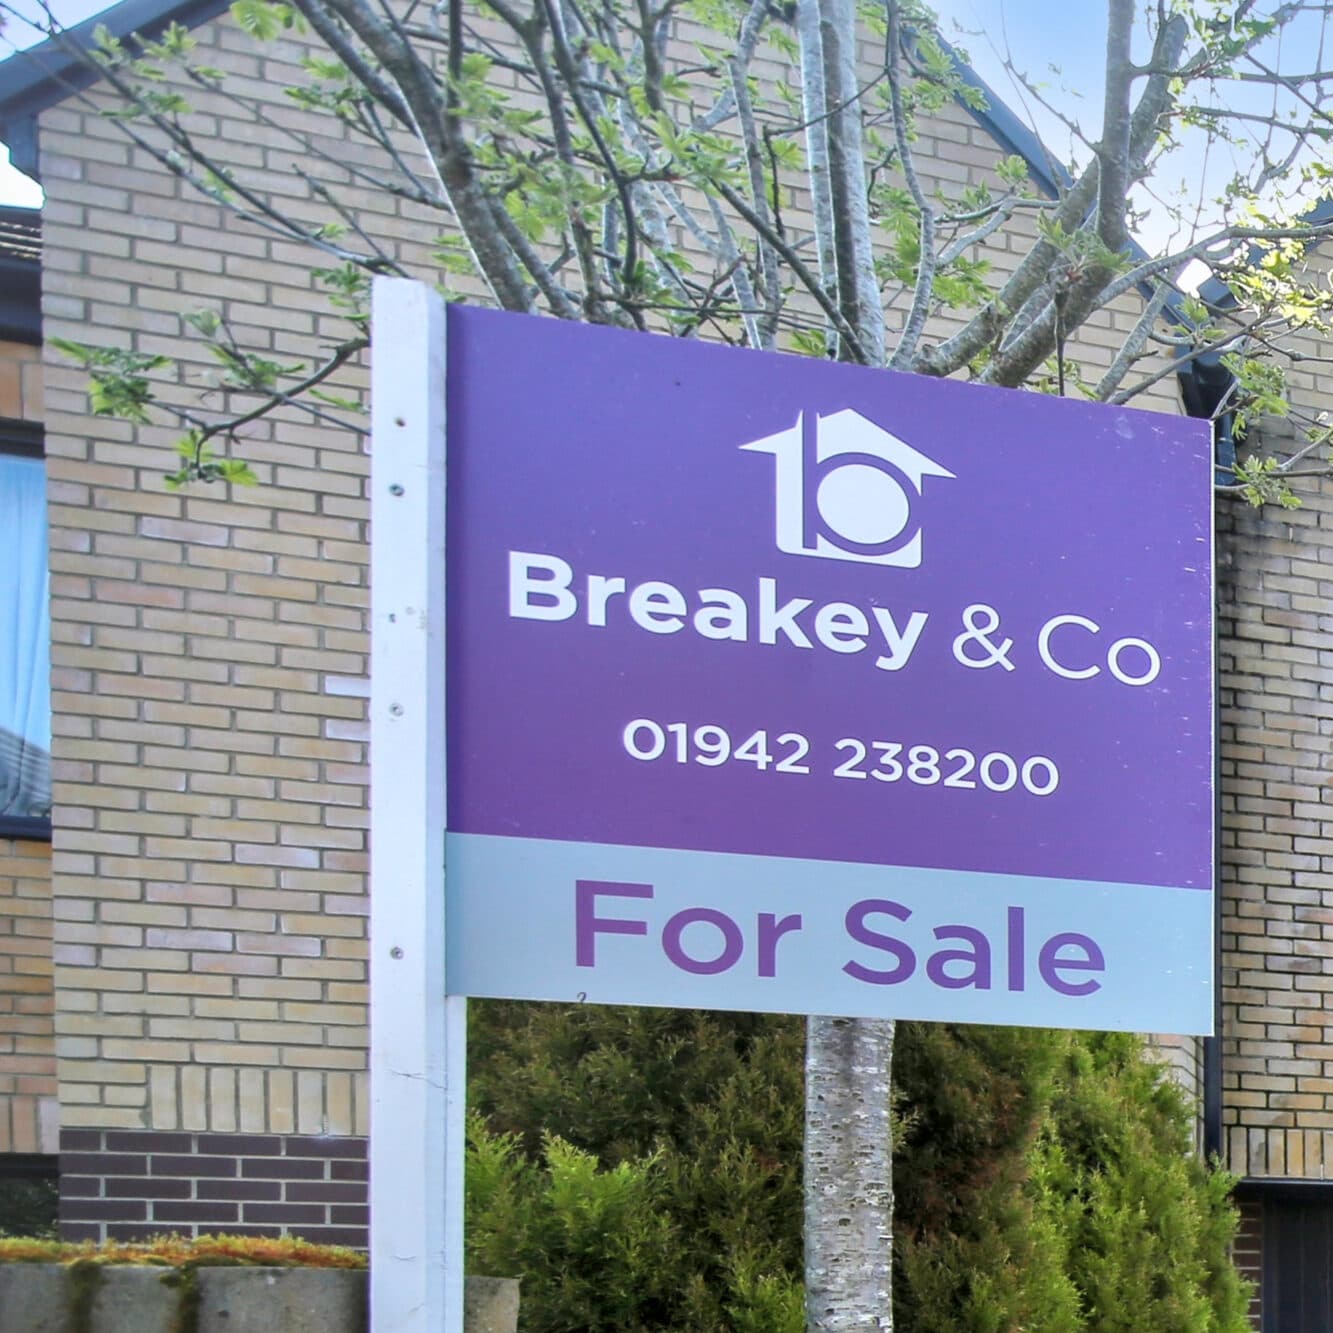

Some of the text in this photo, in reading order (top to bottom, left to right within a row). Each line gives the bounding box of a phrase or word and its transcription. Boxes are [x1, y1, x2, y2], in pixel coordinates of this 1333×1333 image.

[508, 550, 1161, 687] Breakey & Co
[623, 718, 1060, 796] 01942 238200
[575, 879, 1106, 997] For Sale
